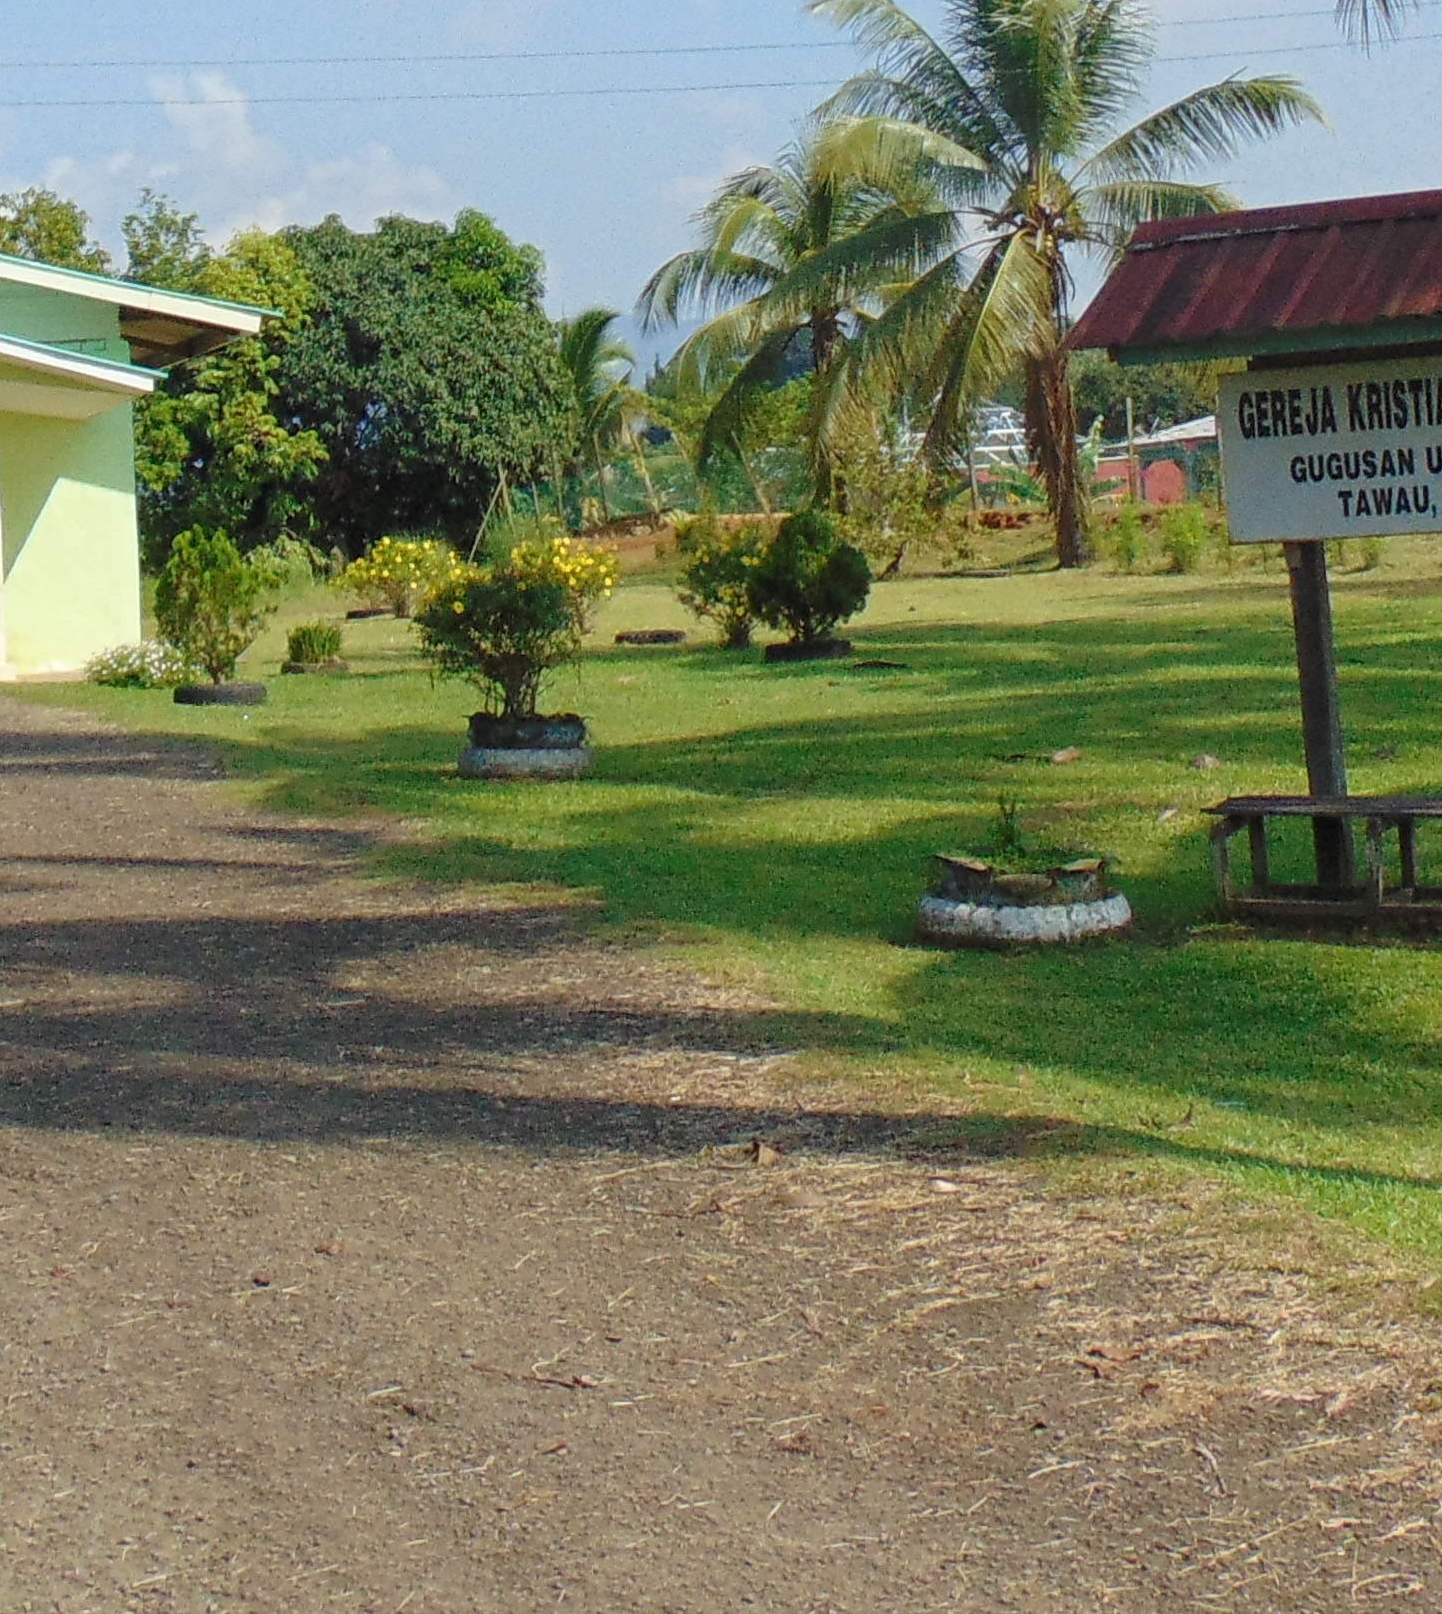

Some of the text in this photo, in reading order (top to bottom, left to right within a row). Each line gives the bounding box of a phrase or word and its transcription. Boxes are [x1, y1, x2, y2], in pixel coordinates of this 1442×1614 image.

[1237, 389, 1338, 440] GEREJA
[1289, 447, 1415, 484] GUGUSAN
[1338, 487, 1438, 519] TAWAU,
